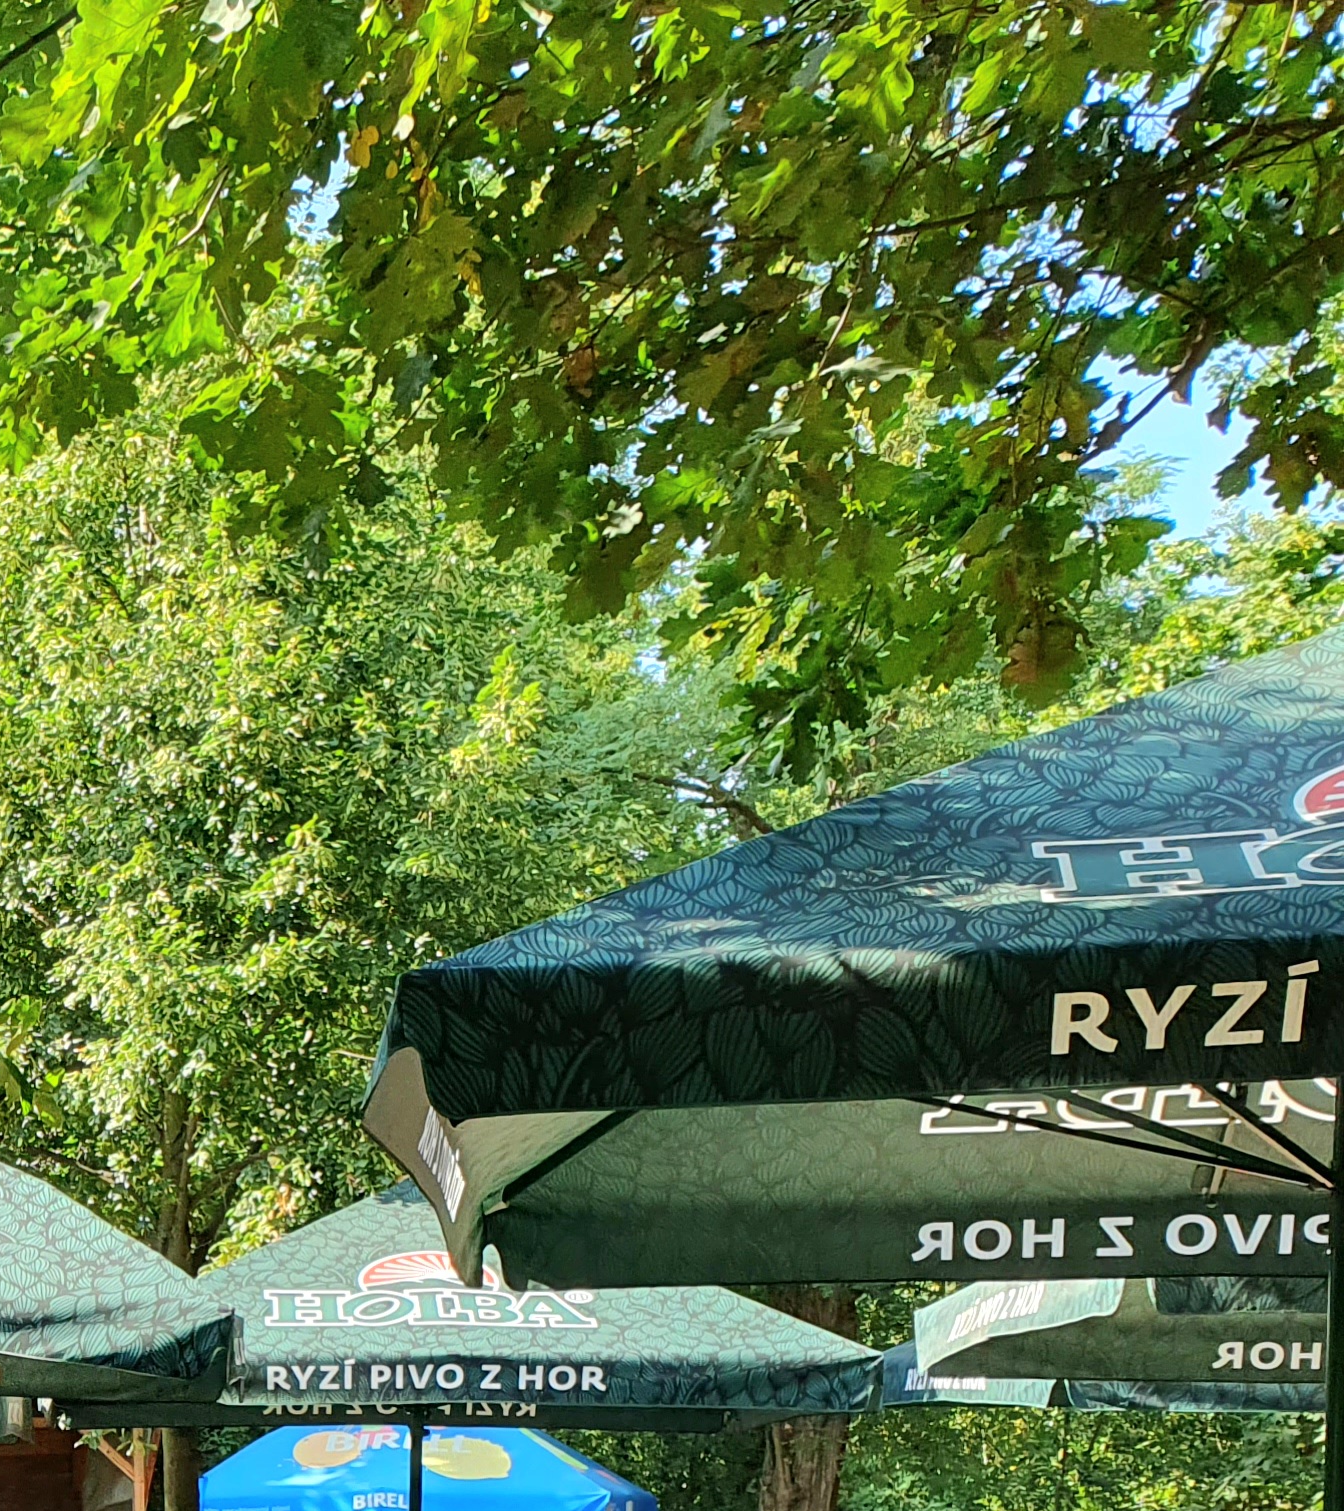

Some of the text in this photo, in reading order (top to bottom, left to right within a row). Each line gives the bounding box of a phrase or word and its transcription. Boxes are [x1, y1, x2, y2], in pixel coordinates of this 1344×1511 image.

[1050, 959, 1320, 1056] RYZÍ
[263, 1288, 599, 1329] HOLBA
[265, 1358, 607, 1392] RYZÍ PIVO Z HOR
[351, 1490, 408, 1510] BIREL
